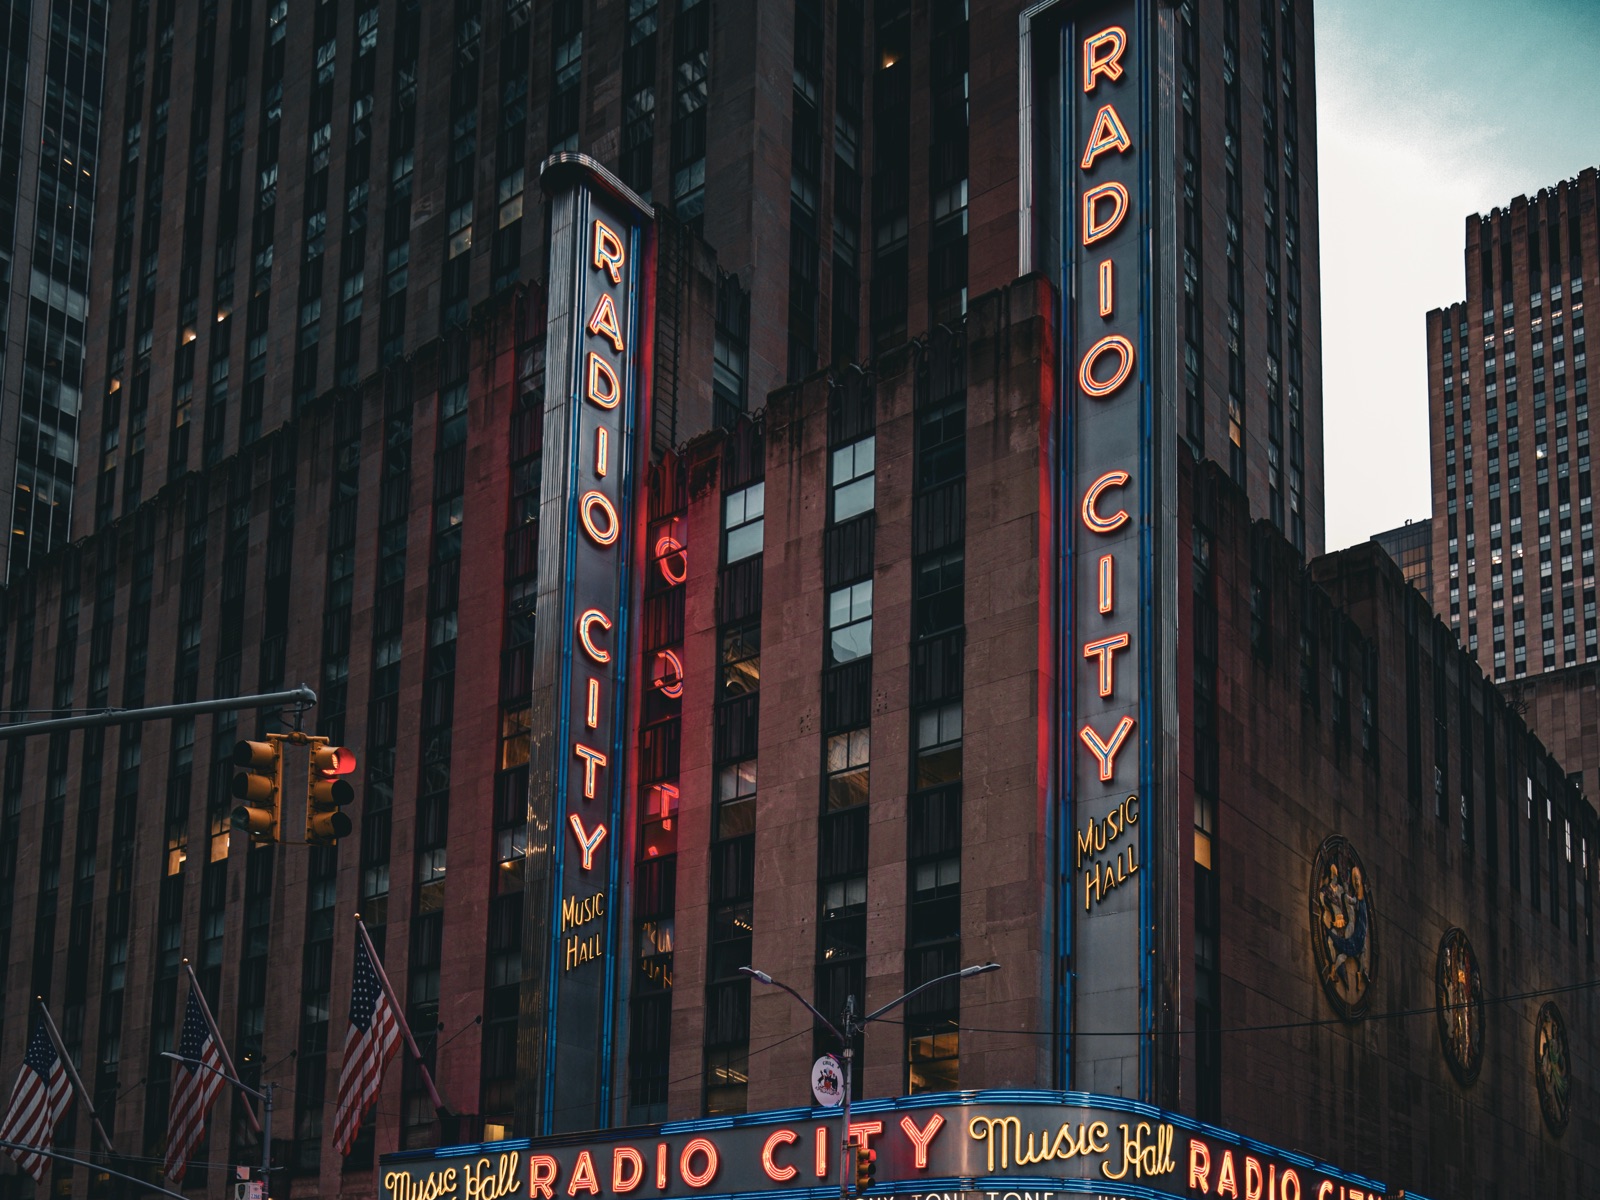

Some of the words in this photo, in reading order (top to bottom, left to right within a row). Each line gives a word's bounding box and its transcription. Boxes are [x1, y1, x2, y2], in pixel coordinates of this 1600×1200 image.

[1079, 26, 1136, 397] RADIO
[581, 219, 625, 546] RADIO
[570, 608, 612, 870] CITY
[1080, 470, 1137, 782] CITY
[529, 1137, 719, 1199] RADIO
[762, 1113, 945, 1181] CITY
[970, 1116, 1109, 1172] Music
[1102, 1121, 1176, 1180] Hall
